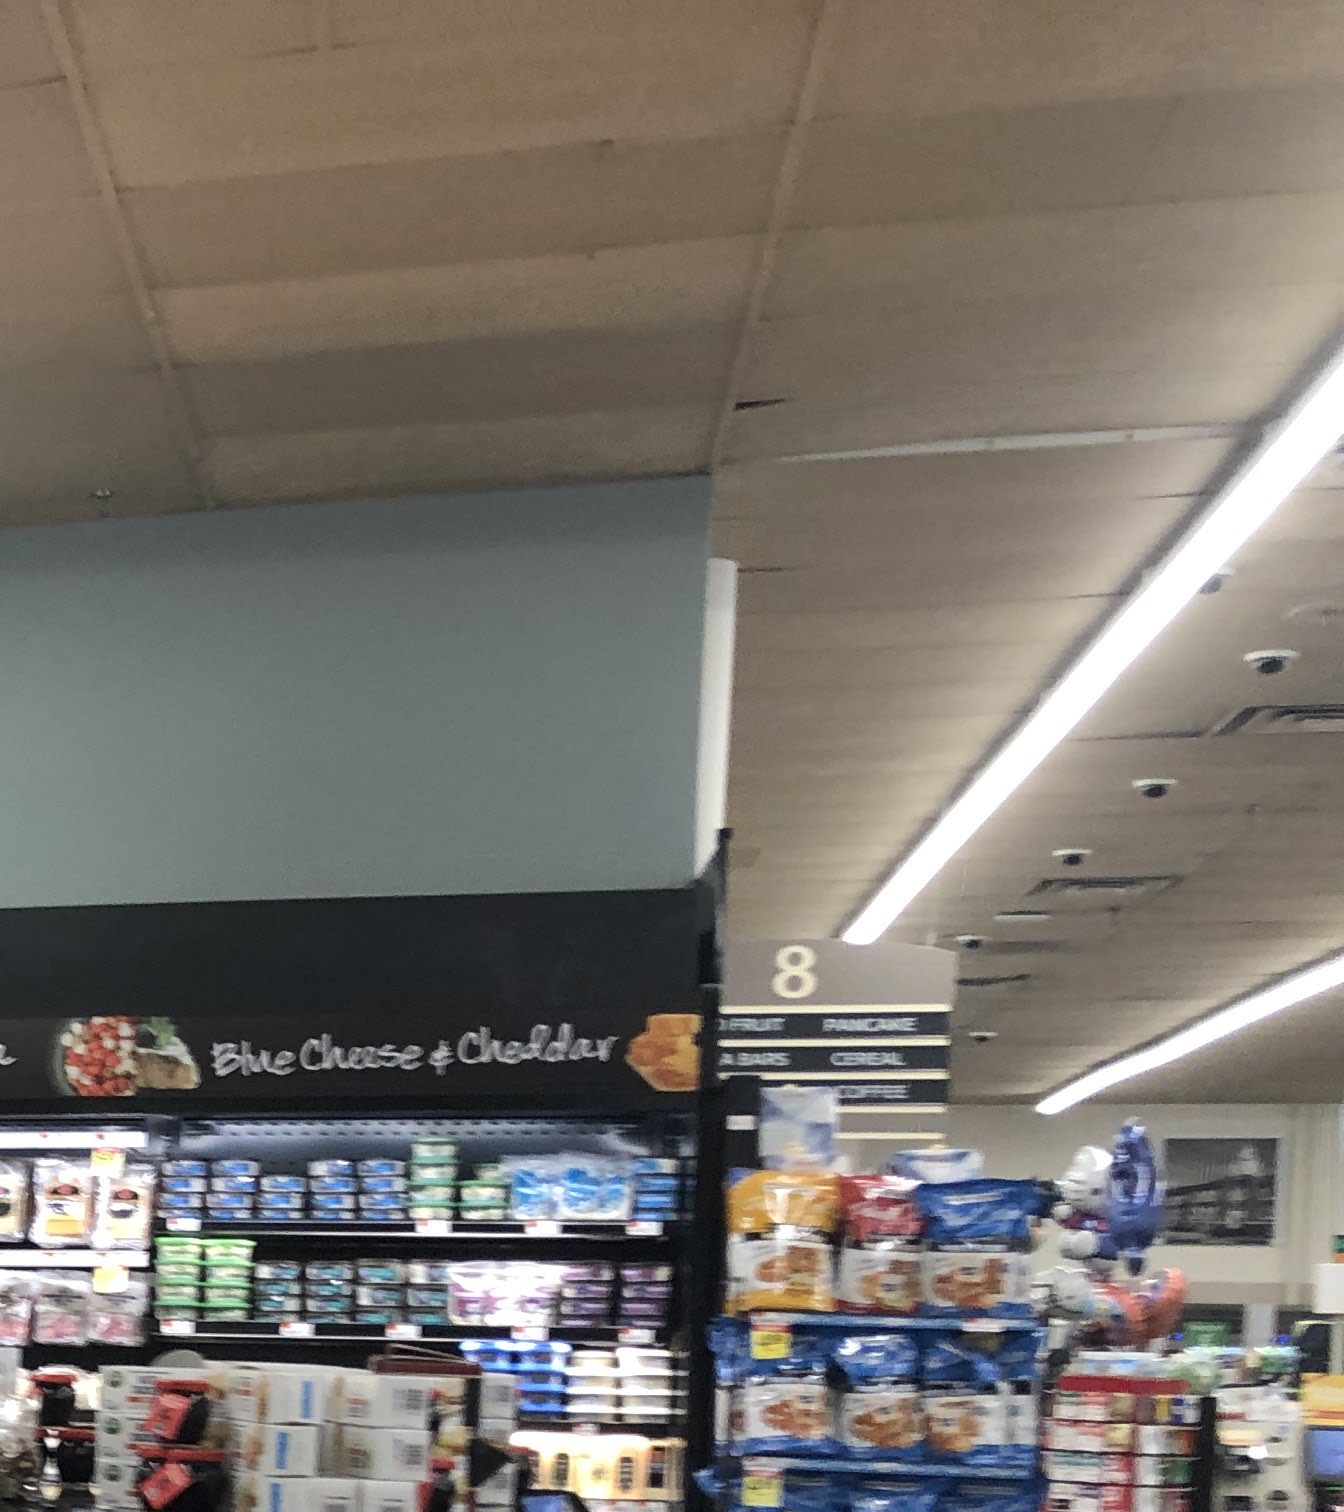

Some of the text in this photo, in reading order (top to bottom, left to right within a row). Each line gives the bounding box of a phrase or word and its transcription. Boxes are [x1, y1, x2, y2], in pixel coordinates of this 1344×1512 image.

[771, 945, 818, 998] 8
[211, 1040, 296, 1076] Blue
[299, 1033, 425, 1070] Cheese
[456, 1023, 620, 1066] Cheddar
